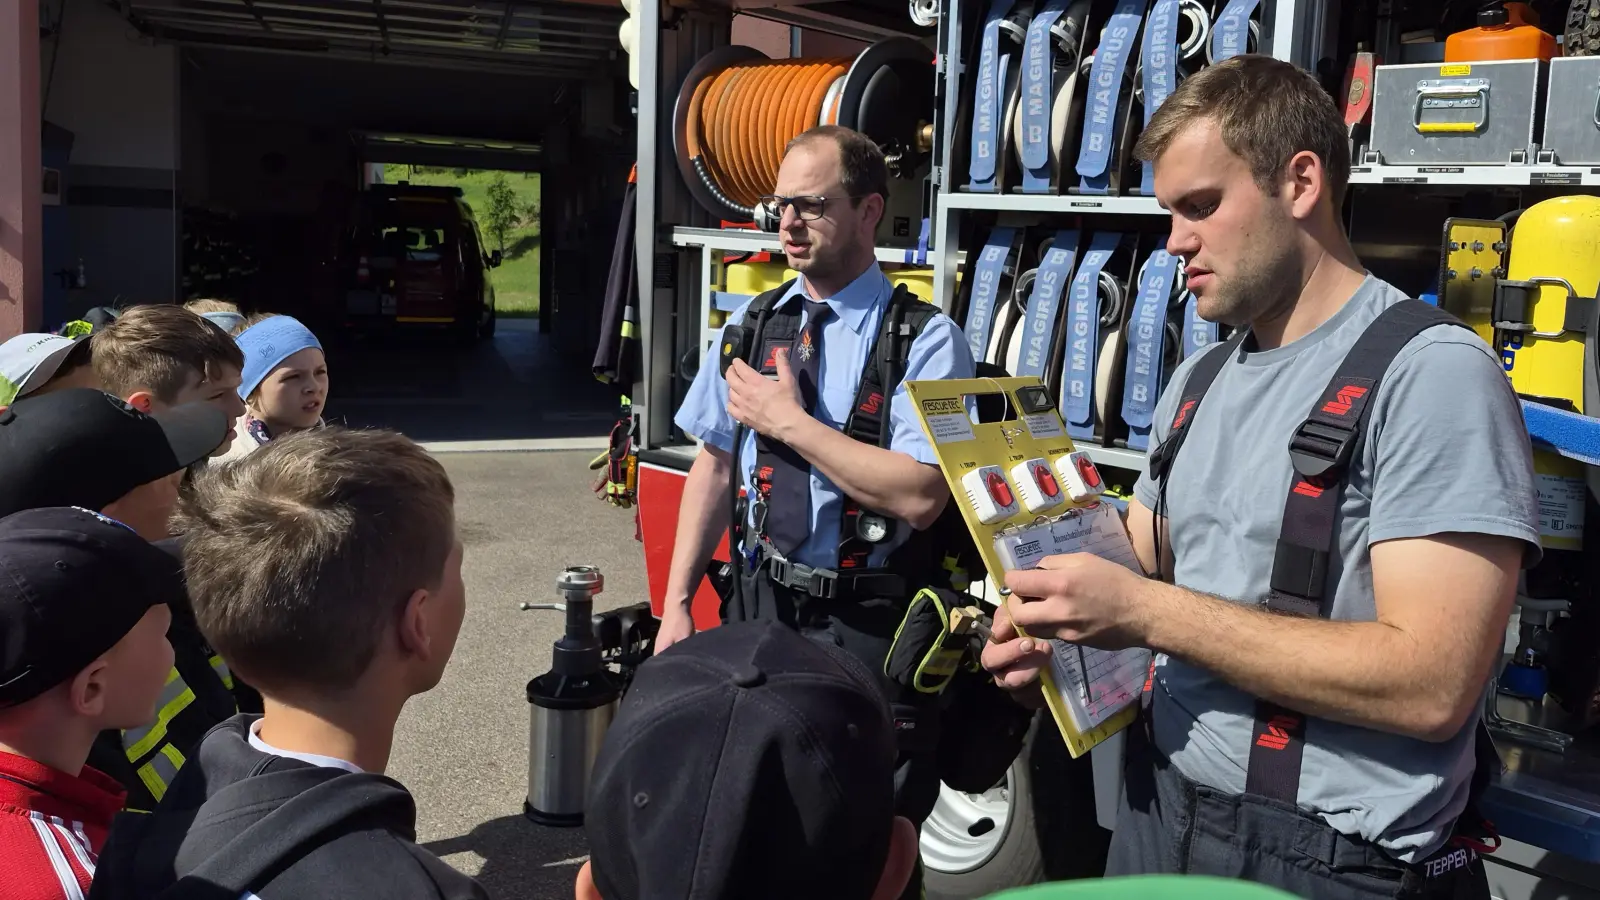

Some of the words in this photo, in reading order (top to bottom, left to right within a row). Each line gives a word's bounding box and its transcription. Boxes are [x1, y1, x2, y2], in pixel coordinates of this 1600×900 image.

[1222, 5, 1244, 57] IRUS
[1029, 18, 1048, 116] MAGIRUS
[1093, 26, 1129, 124] MAGIRUS
[979, 35, 993, 133] MAGIRUS
[1029, 125, 1042, 144] B
[1089, 132, 1103, 152] B
[978, 140, 990, 158] B
[985, 247, 1001, 262] B
[1086, 252, 1103, 266] B
[1154, 249, 1171, 267] B
[1026, 270, 1058, 368] MAGIRUS
[1050, 250, 1069, 265] B
[1072, 271, 1090, 371] MAGIRUS
[1135, 275, 1164, 376] MAGIRUS
[1071, 380, 1084, 398] B
[1132, 383, 1147, 402] B
[1424, 848, 1468, 877] TEPPER
